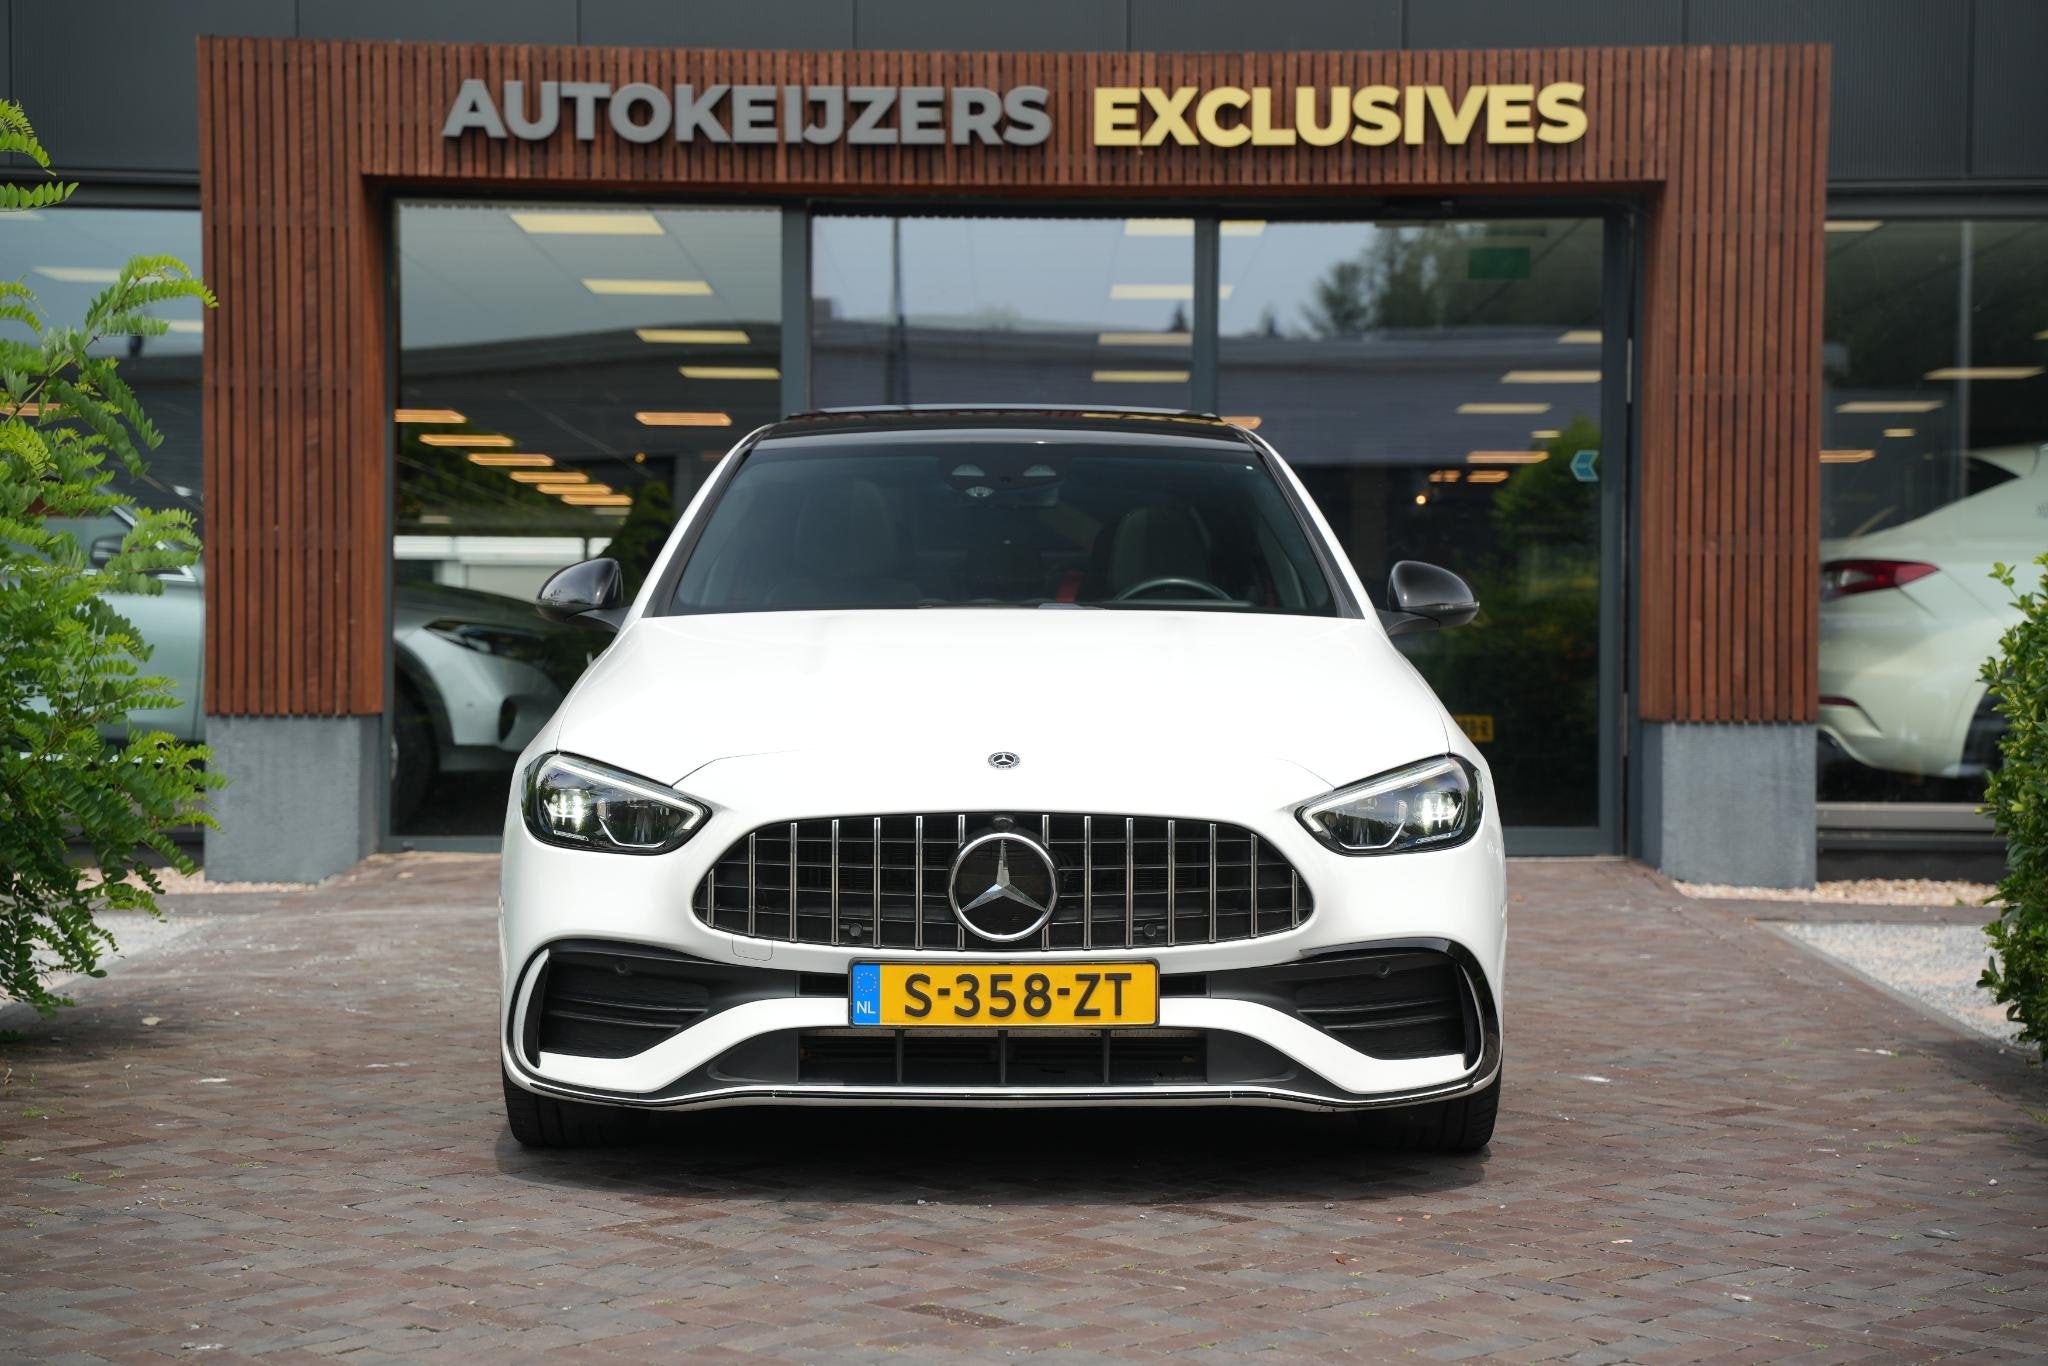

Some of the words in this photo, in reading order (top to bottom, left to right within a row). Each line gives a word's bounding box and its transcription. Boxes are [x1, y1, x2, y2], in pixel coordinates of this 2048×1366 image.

[442, 78, 1052, 146] AUTOKEIJZERS
[1093, 81, 1588, 148] EXCLUSIVES
[856, 1000, 876, 1015] NL
[904, 972, 1132, 1018] S-358-ZT
